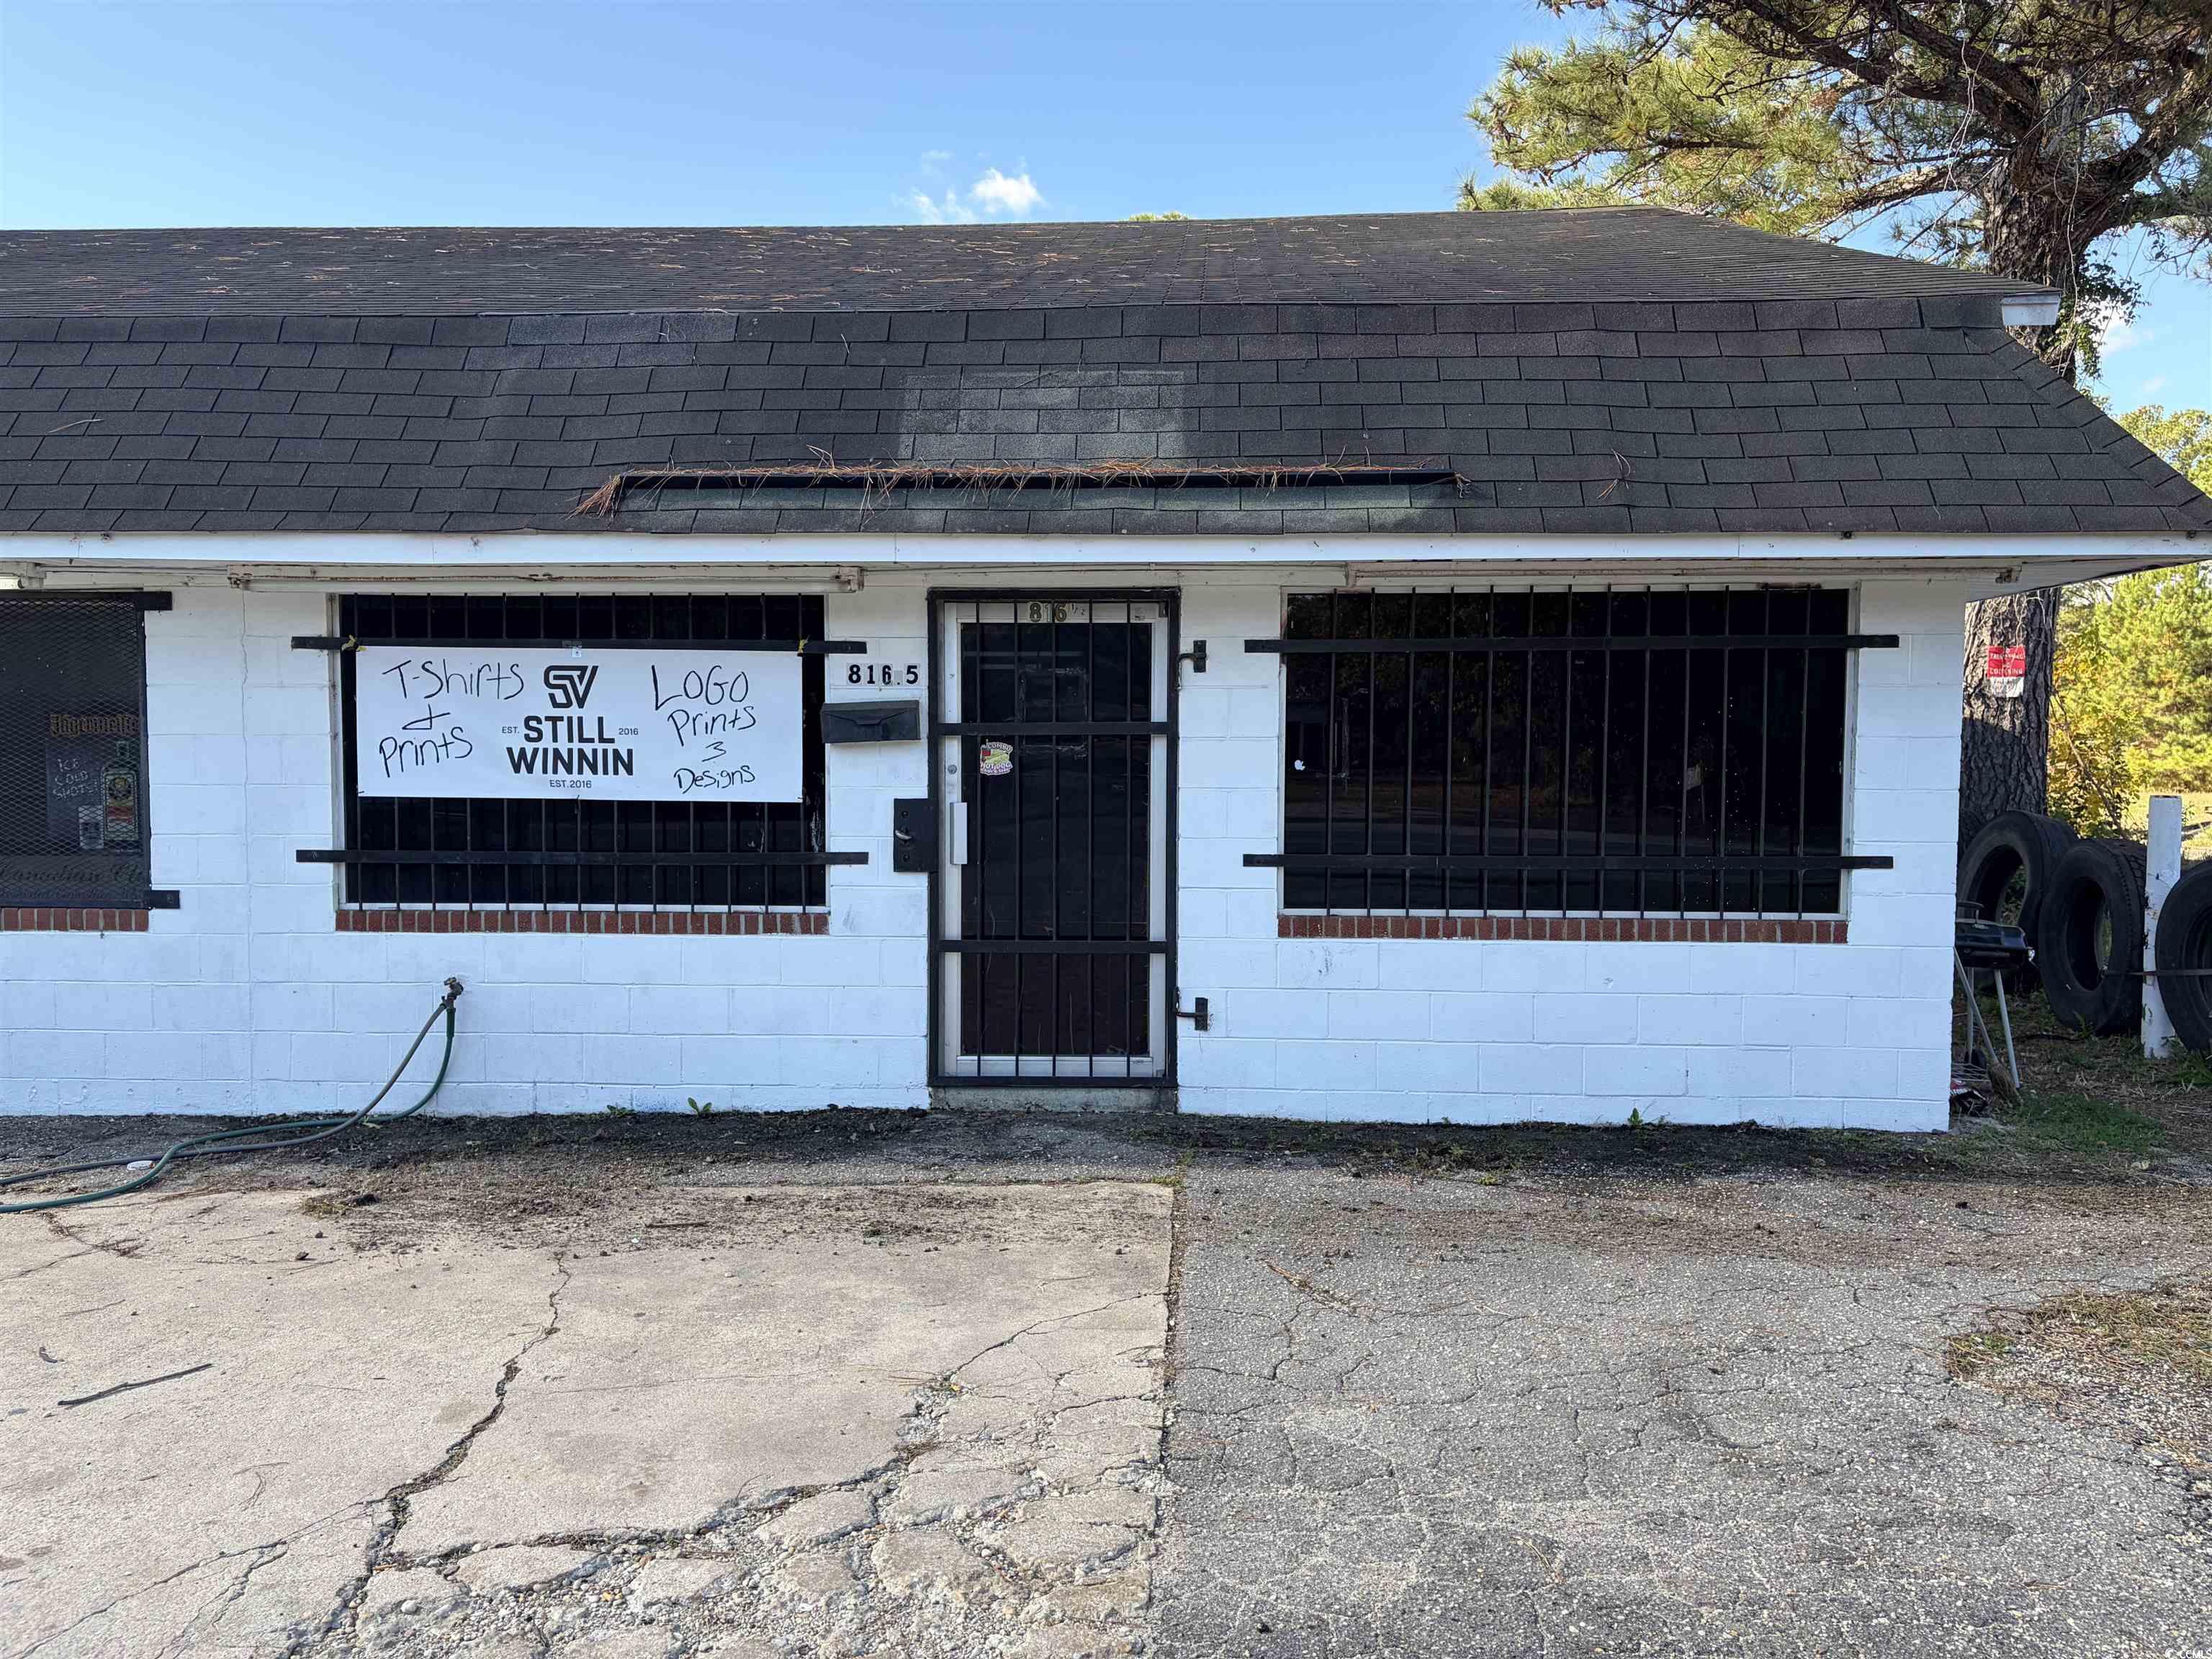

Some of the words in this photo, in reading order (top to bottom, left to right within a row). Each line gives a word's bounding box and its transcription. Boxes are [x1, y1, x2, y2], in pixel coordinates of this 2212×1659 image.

[1029, 603, 1067, 623] 816
[382, 659, 524, 700] T-Shirts
[651, 665, 749, 711] LOGO
[848, 664, 919, 685] 816.5
[523, 716, 616, 744] STILL
[506, 747, 634, 775] WINNIN
[673, 765, 755, 794] Designs
